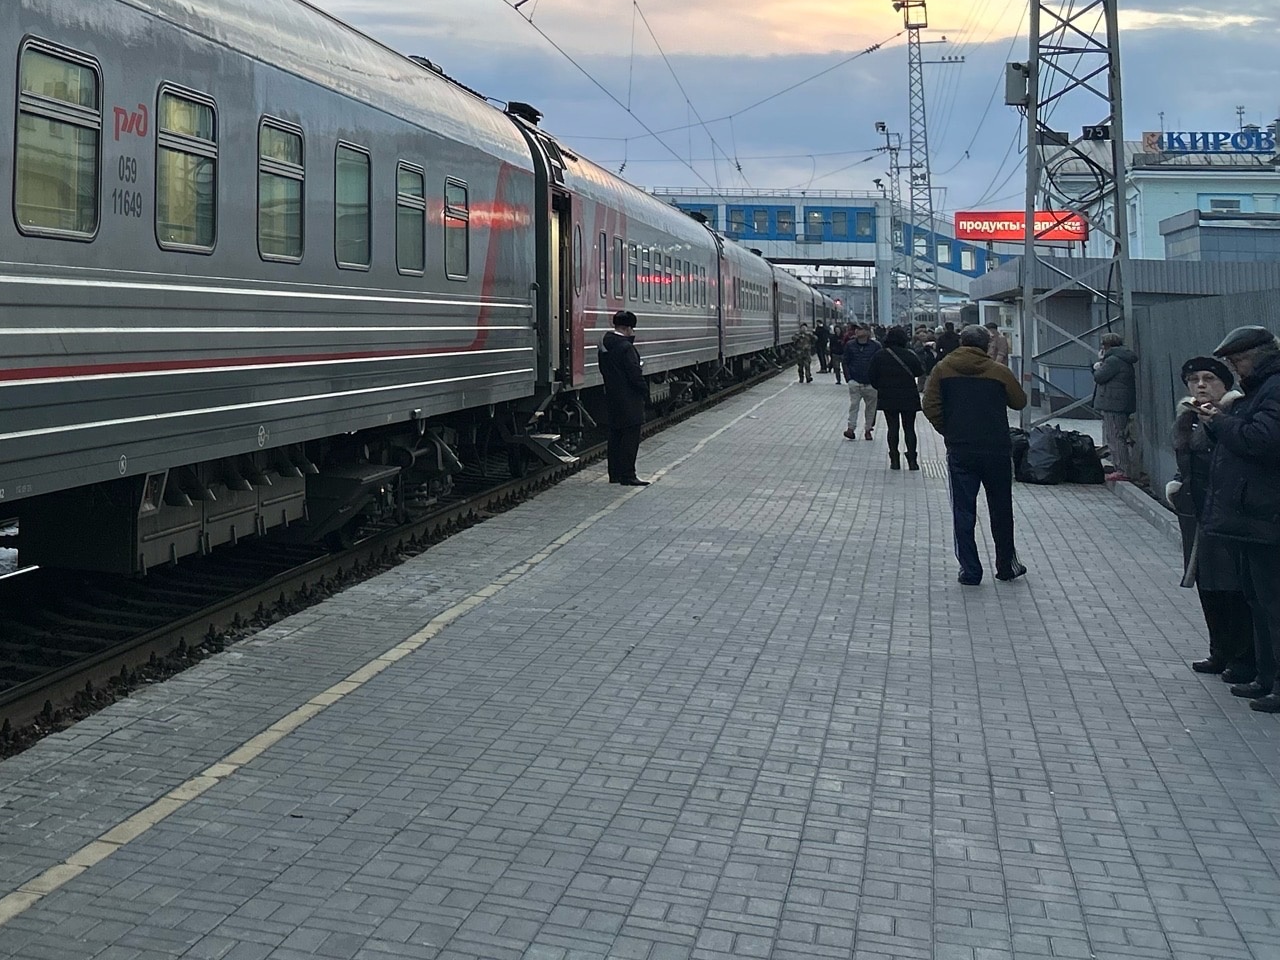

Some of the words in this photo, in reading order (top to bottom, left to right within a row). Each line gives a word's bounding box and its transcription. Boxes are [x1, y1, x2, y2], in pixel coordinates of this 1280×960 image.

[1086, 127, 1104, 139] 75
[1165, 131, 1275, 151] КИРОВ
[118, 155, 137, 183] 059
[112, 188, 142, 218] 11649
[959, 220, 1020, 233] продукты
